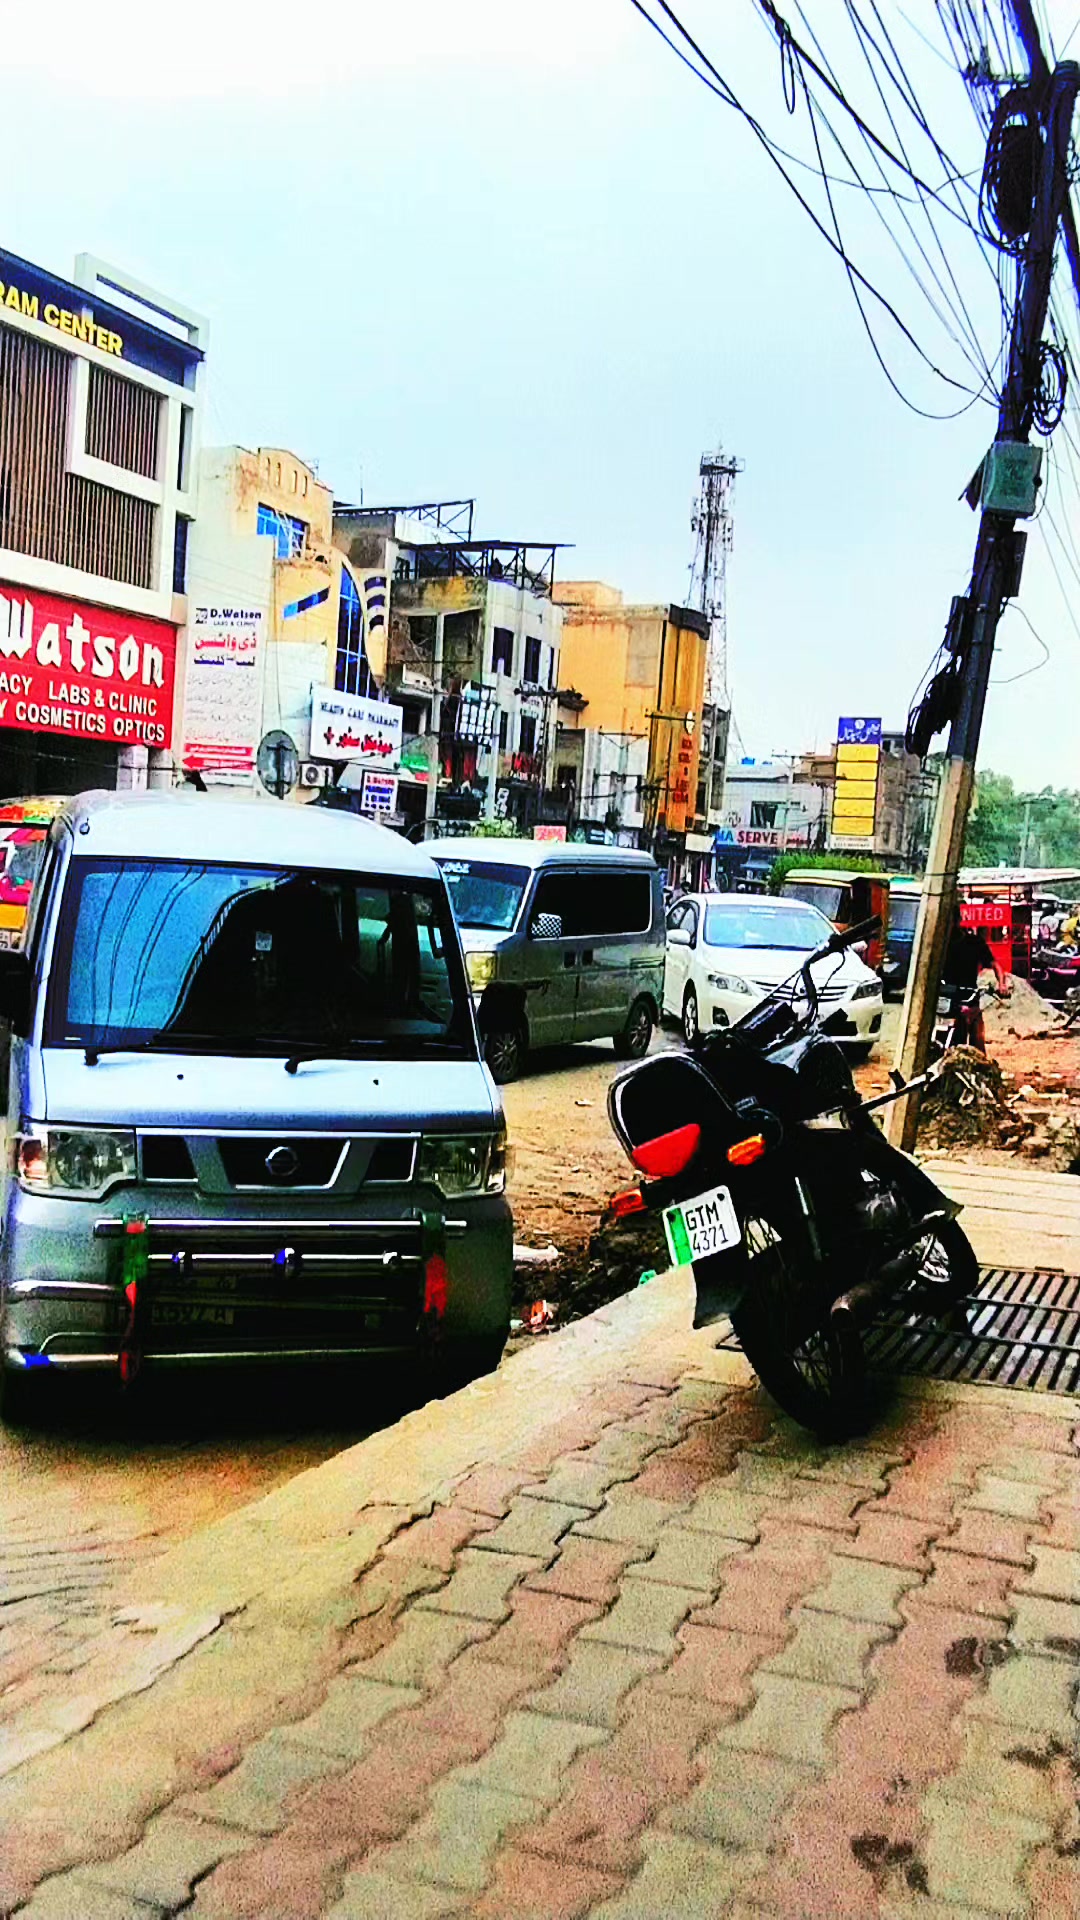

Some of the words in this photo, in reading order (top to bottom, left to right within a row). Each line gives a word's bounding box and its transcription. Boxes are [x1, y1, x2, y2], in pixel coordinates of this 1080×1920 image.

[44, 303, 124, 357] CENTER
[48, 680, 91, 707] LABS
[94, 689, 105, 708] &
[109, 692, 157, 717] CLINIC
[16, 701, 106, 734] COSMETICS
[113, 717, 165, 742] OPTICS
[737, 830, 778, 845] SERVE
[960, 907, 1004, 921] NITED
[685, 1200, 720, 1231] GTM
[692, 1223, 729, 1254] 4371
